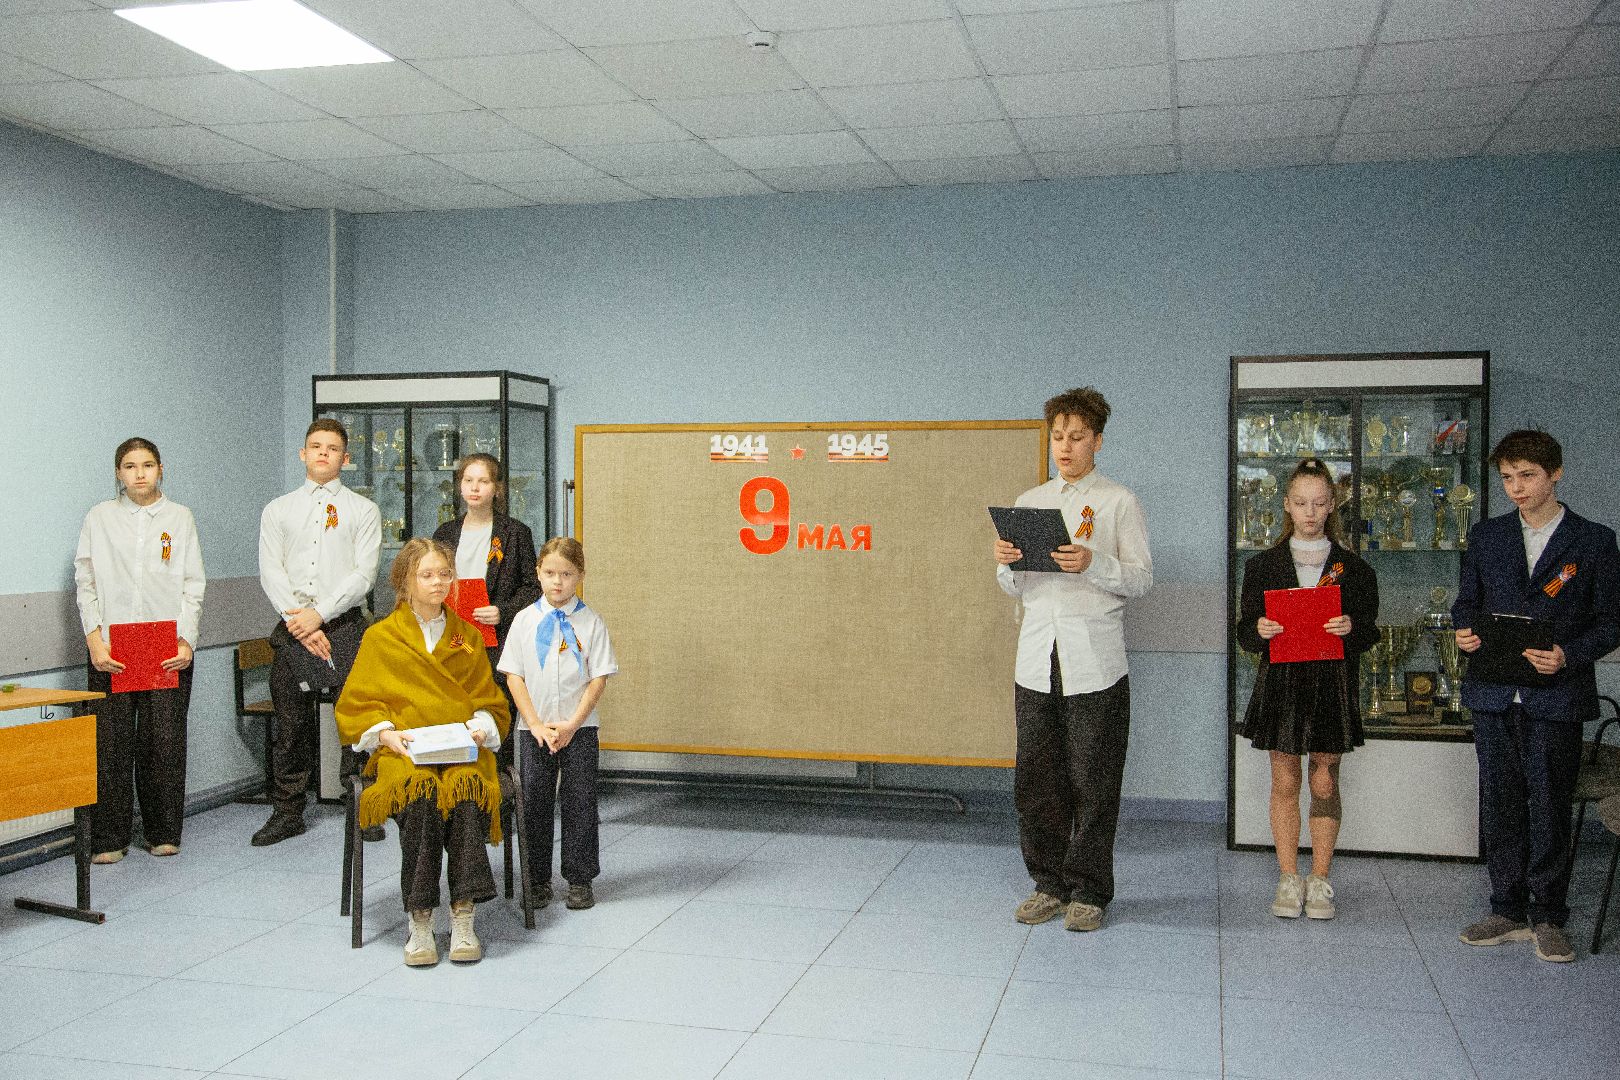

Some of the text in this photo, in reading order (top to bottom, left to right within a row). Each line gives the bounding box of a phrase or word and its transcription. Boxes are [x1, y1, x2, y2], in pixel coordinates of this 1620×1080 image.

[710, 433, 889, 457] 1941 1945
[738, 475, 873, 555] 9 МАЯ
